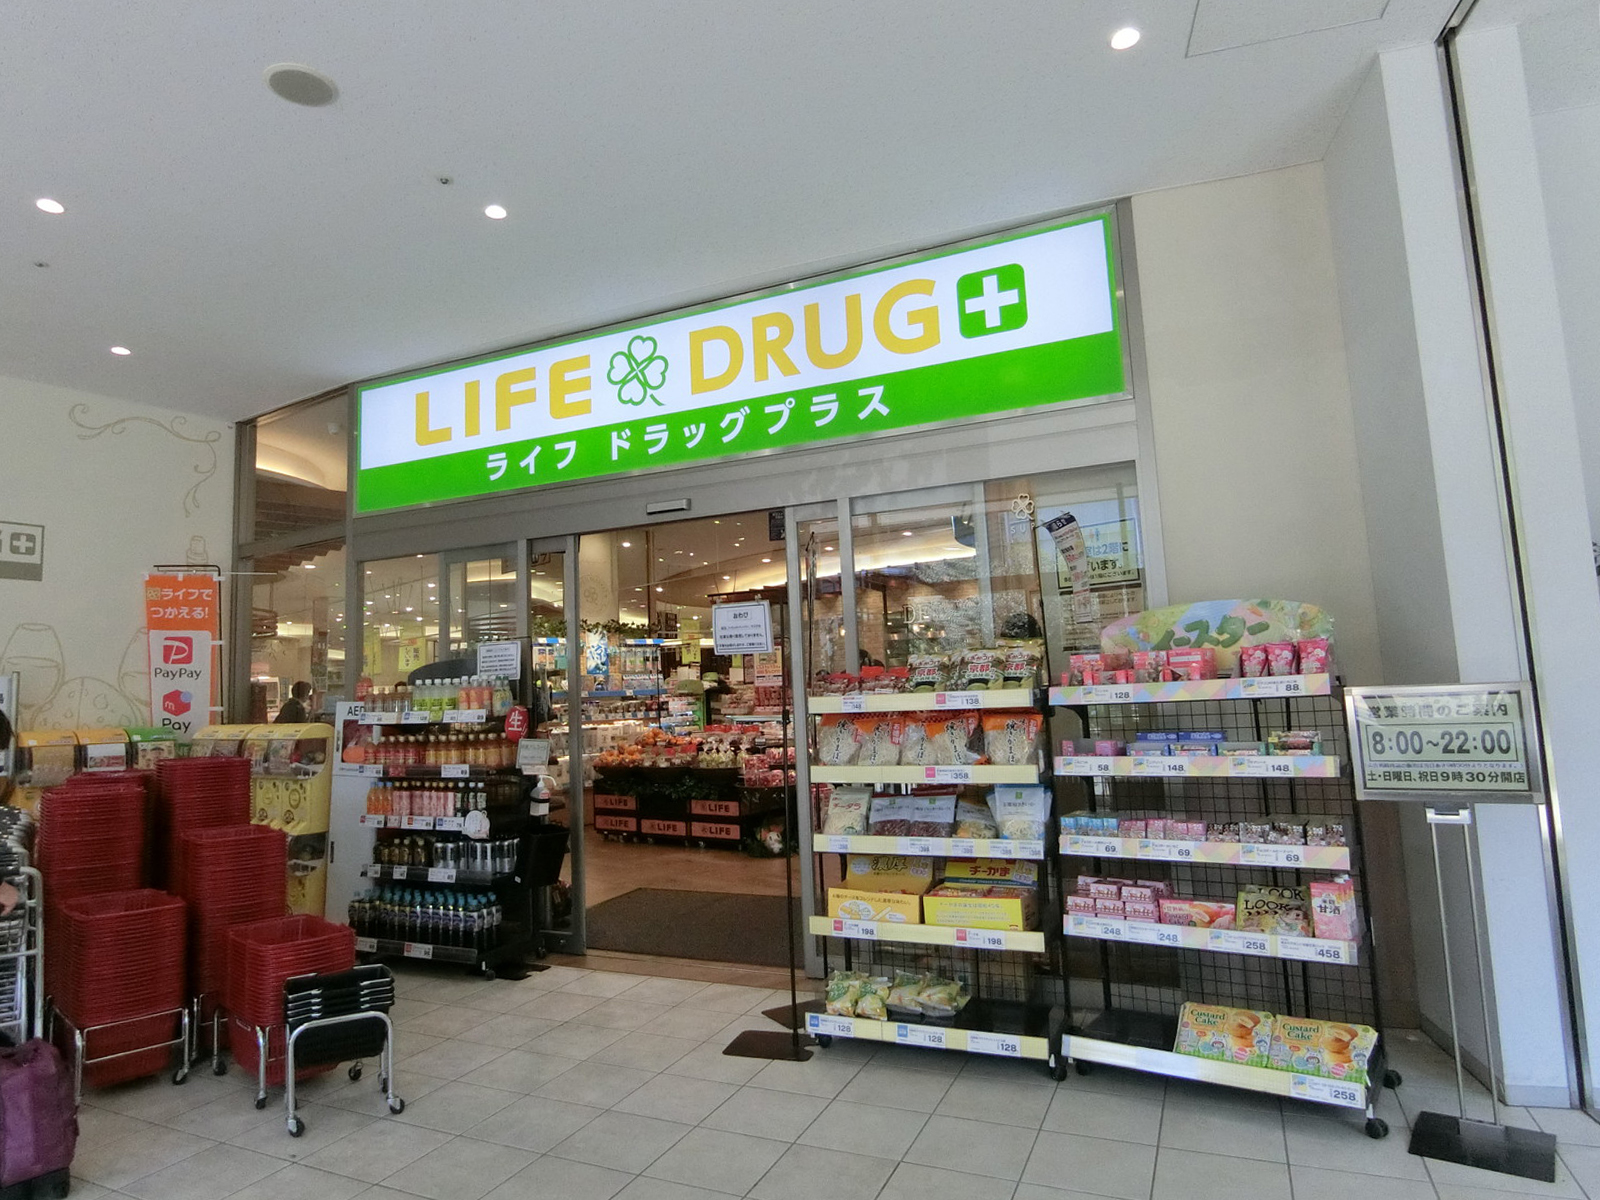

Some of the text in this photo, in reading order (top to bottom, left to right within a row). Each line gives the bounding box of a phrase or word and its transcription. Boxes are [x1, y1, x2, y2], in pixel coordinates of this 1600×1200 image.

[415, 278, 941, 447] LIFE DRUG
[486, 385, 891, 482] ライフ ドラッグプラス
[161, 588, 213, 600] ライフで
[154, 667, 202, 680] PayPay
[1285, 683, 1300, 692] 88
[1114, 691, 1130, 700] 128
[1368, 702, 1509, 719] 営業時間のご案内
[162, 718, 191, 733] Pay
[509, 711, 523, 731] 生
[1097, 764, 1110, 772] 58
[1167, 764, 1184, 772] 148
[1271, 764, 1290, 772] 148
[953, 772, 969, 780] 358
[609, 797, 628, 807] LIFE
[707, 803, 730, 813] LIFE
[610, 818, 629, 828] LIFE
[657, 822, 678, 832] LIFE
[709, 825, 731, 836] LIFE
[1105, 844, 1117, 853] 69
[1178, 849, 1190, 857] 69
[872, 856, 907, 871] 濃厚
[1285, 854, 1300, 863] 69
[1244, 899, 1291, 911] LOOK
[1317, 904, 1341, 915] 甘酒
[1103, 926, 1122, 936] 248
[987, 937, 1002, 945] 198
[1159, 933, 1178, 943] 248
[1246, 941, 1266, 951] 258
[1318, 949, 1340, 960] 458
[1190, 1008, 1226, 1021] Custard
[1195, 1016, 1219, 1026] Cake
[837, 1024, 851, 1033] 128
[1282, 1022, 1320, 1034] Custard
[927, 1035, 943, 1043] 128
[1287, 1030, 1313, 1041] Cake
[1000, 1043, 1017, 1052] 128
[1332, 1089, 1356, 1101] 258
